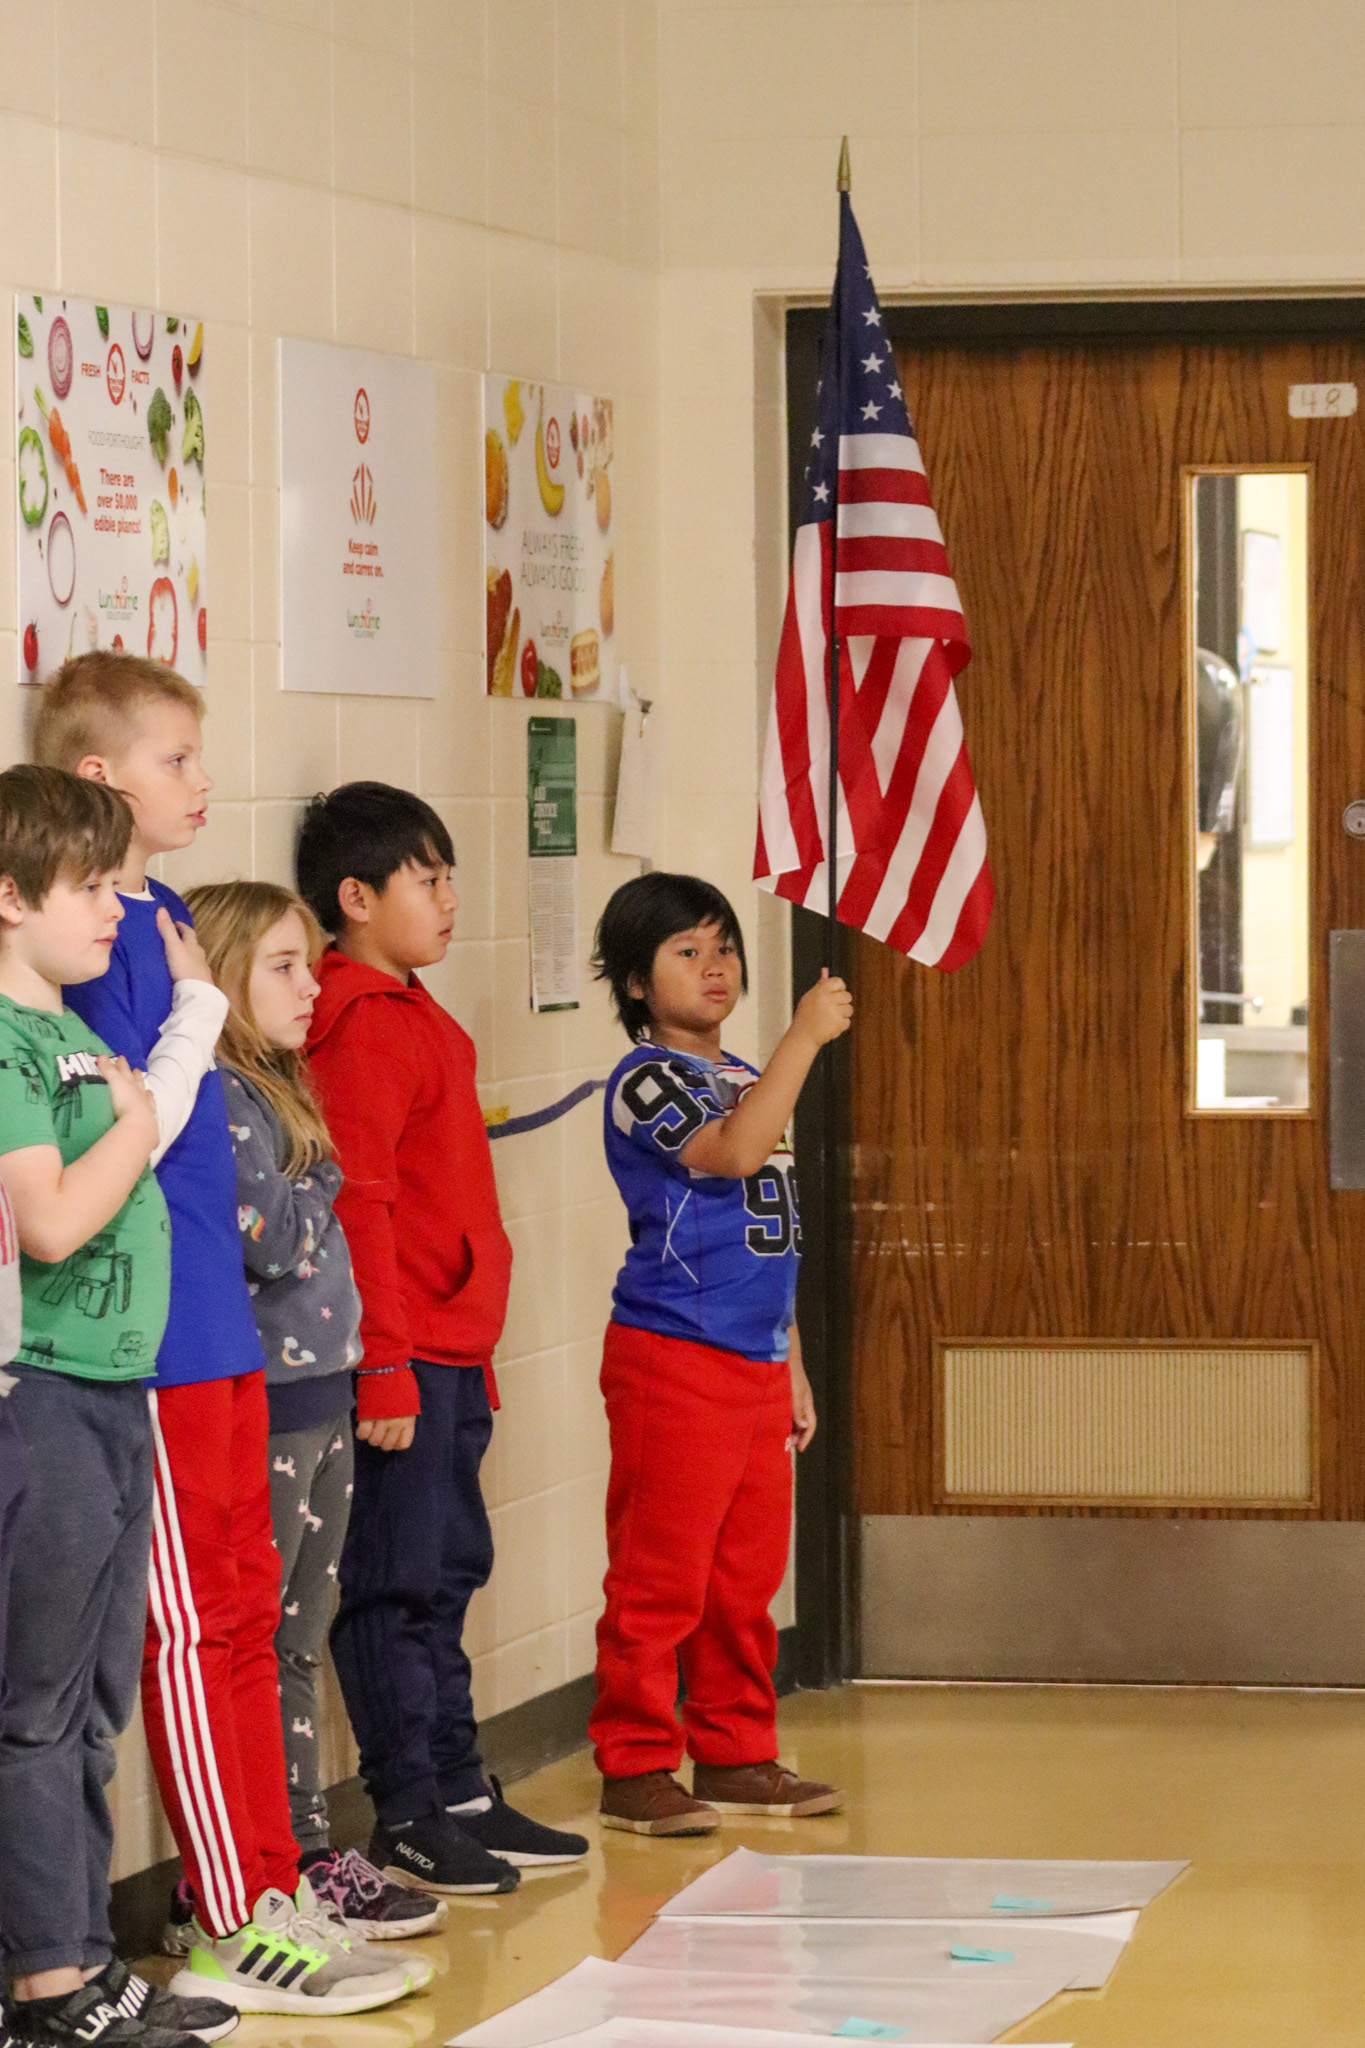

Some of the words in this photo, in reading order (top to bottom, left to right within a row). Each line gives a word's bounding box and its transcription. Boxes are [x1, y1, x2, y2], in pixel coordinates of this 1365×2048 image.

[81, 362, 101, 377] FRESH
[132, 369, 150, 385] FACTS
[100, 468, 121, 486] There
[123, 474, 135, 488] are
[97, 495, 113, 509] over
[115, 492, 137, 511] 50,000
[94, 514, 116, 532] edible
[348, 538, 363, 559] Keep
[364, 540, 379, 556] calm
[521, 529, 559, 559] ALWAYS
[343, 560, 354, 575] and
[520, 561, 557, 589] ALWAYS
[395, 1842, 436, 1871] NAUTICA
